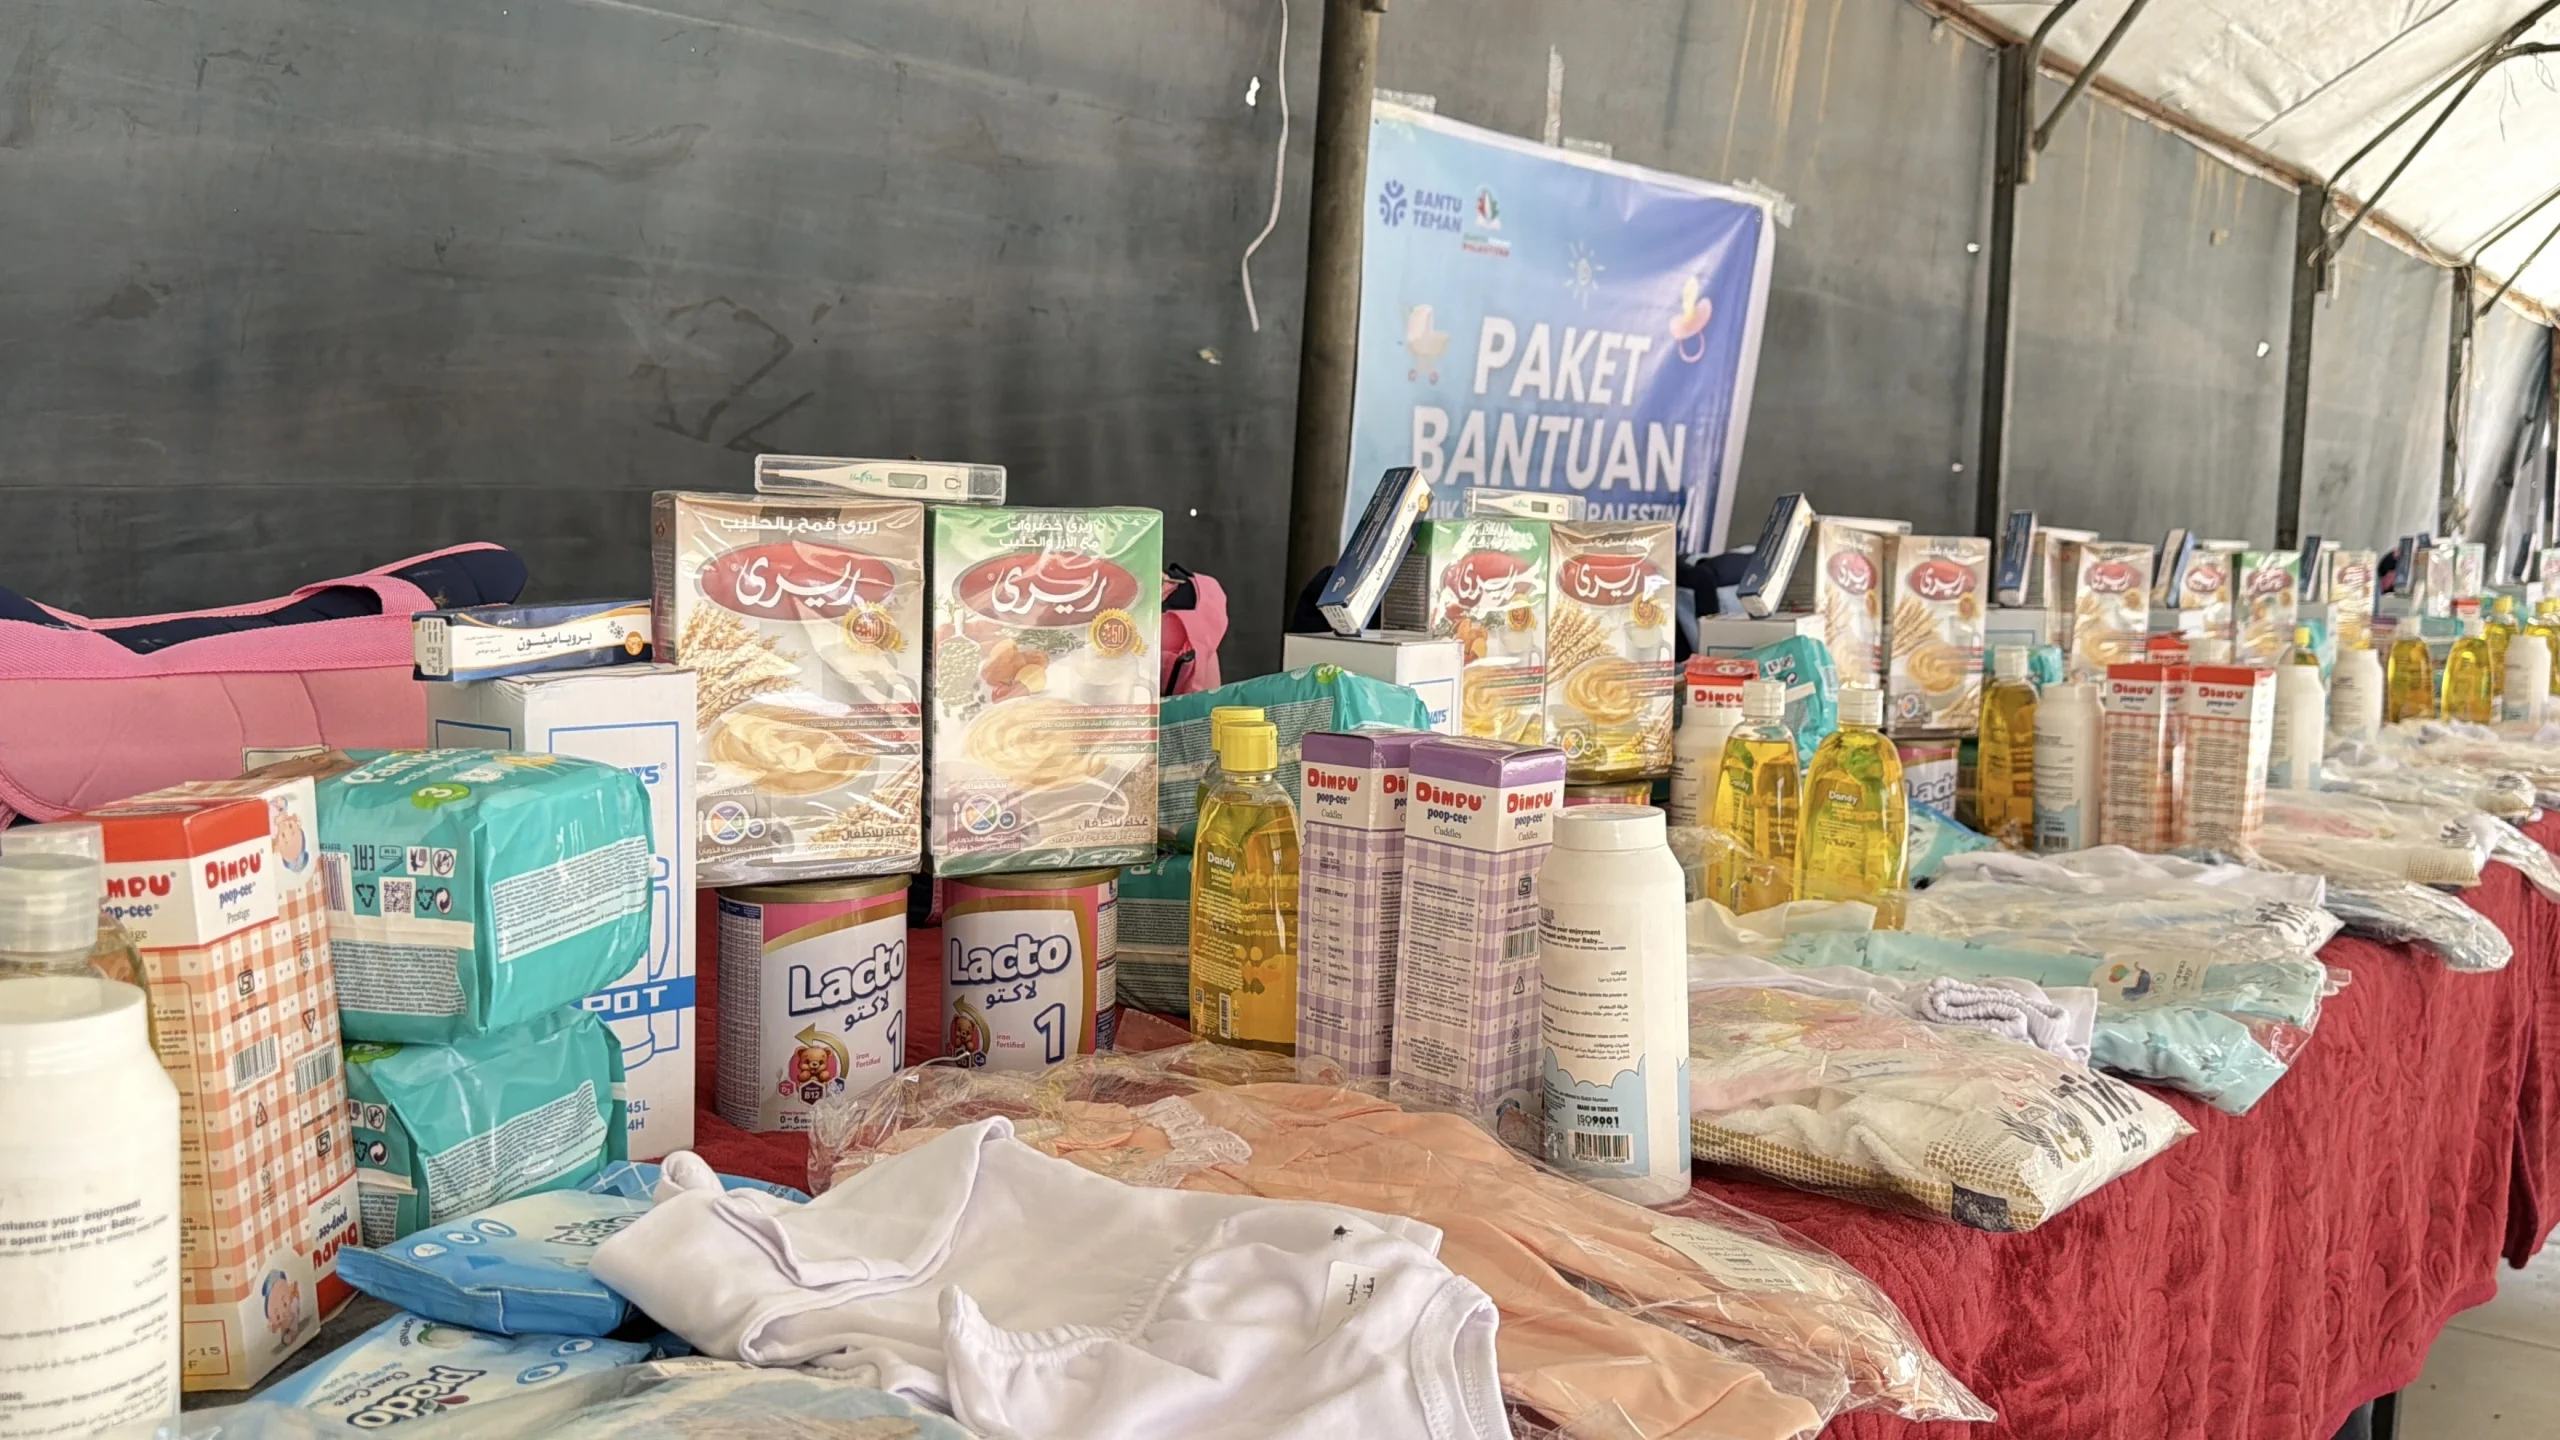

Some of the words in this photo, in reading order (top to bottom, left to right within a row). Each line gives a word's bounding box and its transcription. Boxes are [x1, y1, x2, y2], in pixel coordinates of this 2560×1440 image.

[1413, 189, 1463, 213] BANTU
[1412, 209, 1463, 232] TEMAN
[1473, 316, 1653, 407] PAKET
[1410, 406, 1687, 492] BANTUAN
[418, 787, 453, 799] 3
[1316, 793, 1348, 805] poop-cee
[1828, 790, 1858, 805] Dandy
[1321, 808, 1343, 820] Cuddles
[1427, 807, 1468, 824] poop-cee
[1514, 814, 1543, 829] poop-cee
[1433, 825, 1462, 840] Cuddles
[1517, 831, 1538, 842] Cuddles
[1207, 851, 1236, 871] Dandy
[106, 874, 171, 899] MPU
[950, 933, 1072, 986] Lacto
[788, 938, 906, 1018] Lacto
[985, 980, 1037, 1010] لاكتو
[844, 990, 890, 1033] لاكتو
[886, 1009, 903, 1074] 1
[1033, 1002, 1066, 1065] 1
[804, 1091, 820, 1100] B12
[1576, 1104, 1590, 1112] MADE
